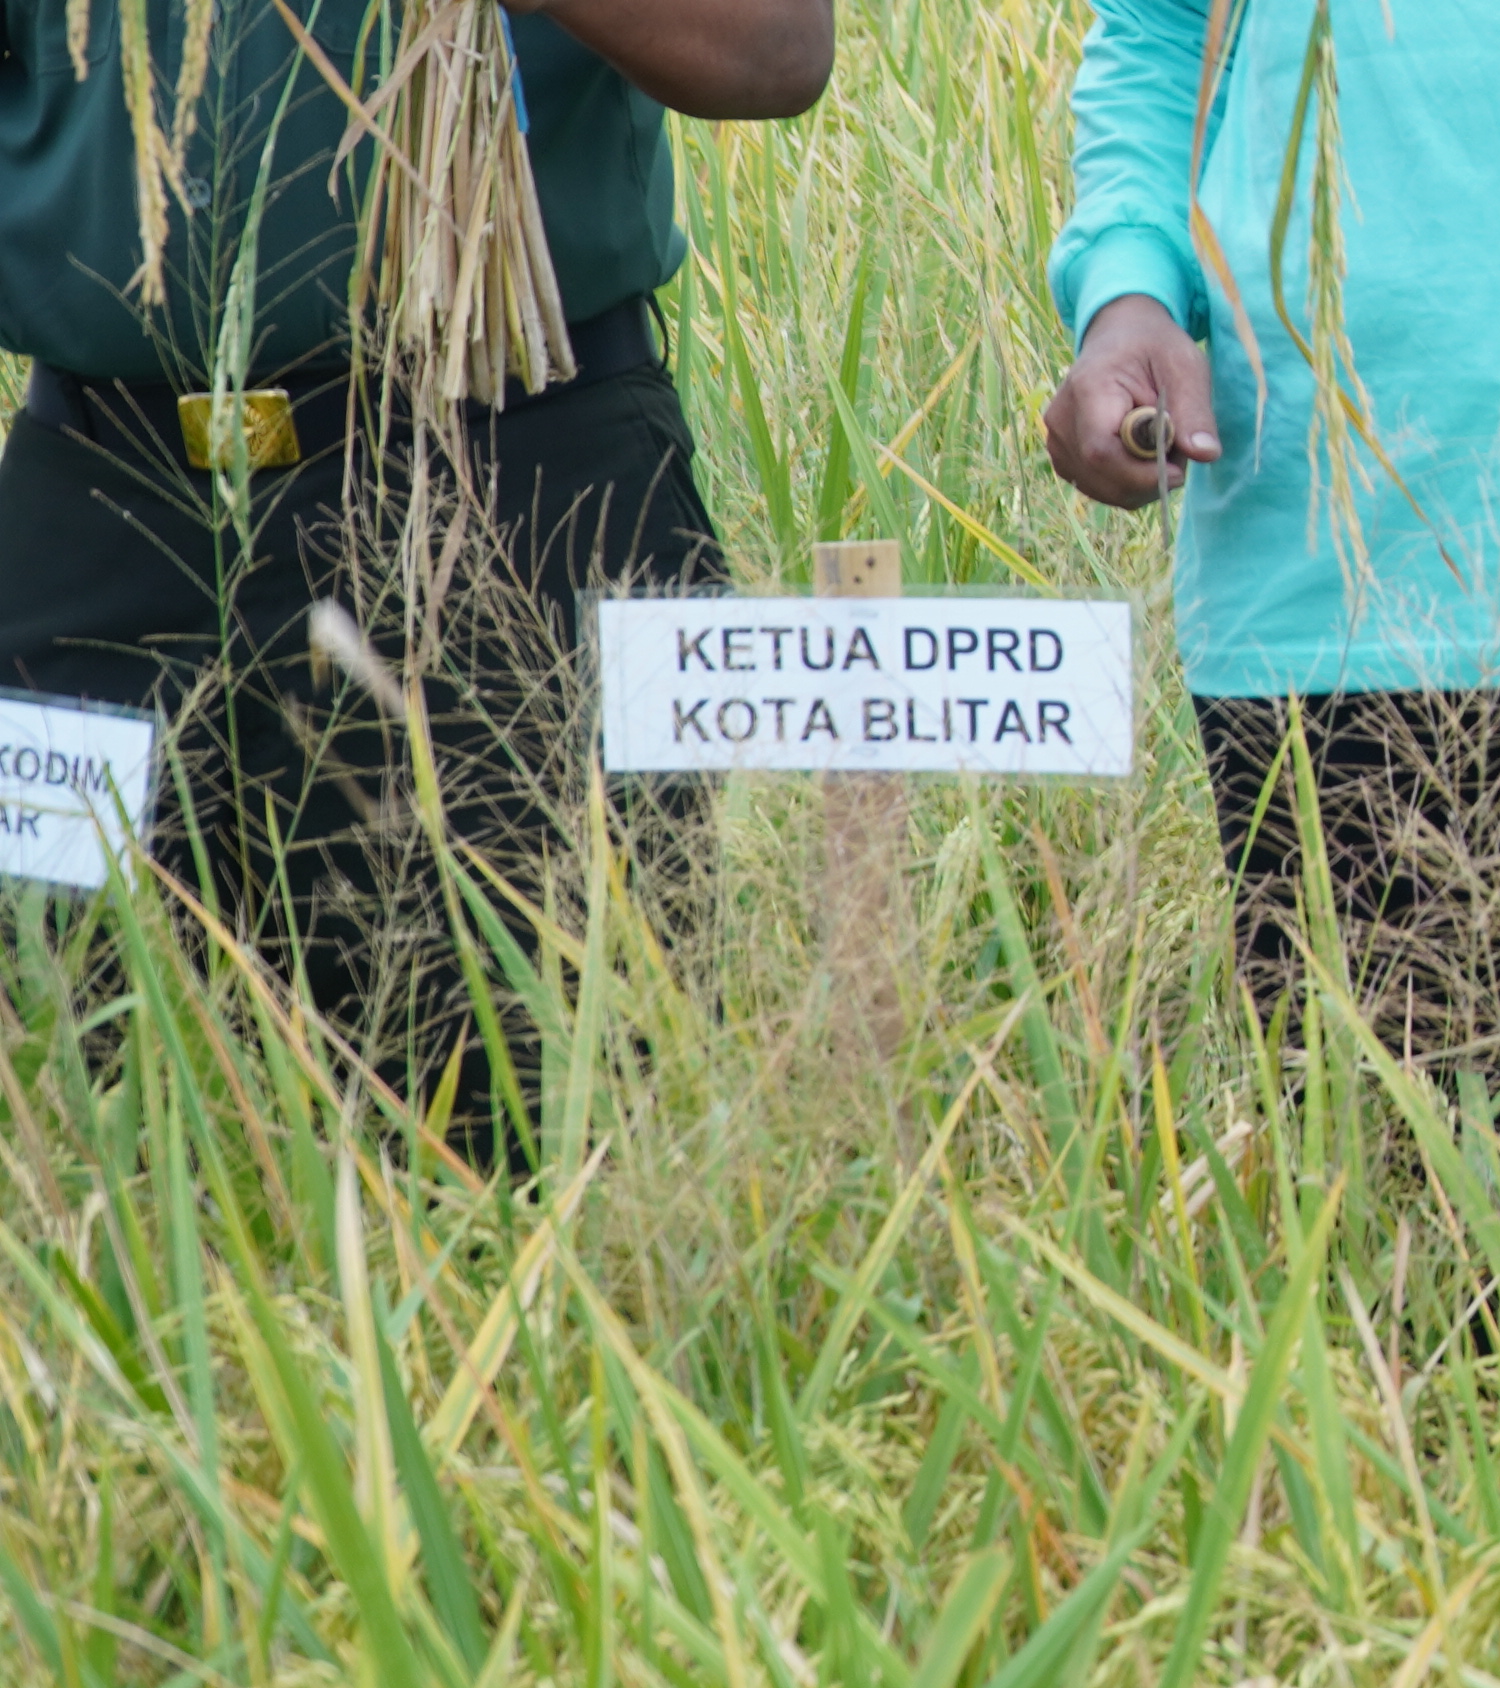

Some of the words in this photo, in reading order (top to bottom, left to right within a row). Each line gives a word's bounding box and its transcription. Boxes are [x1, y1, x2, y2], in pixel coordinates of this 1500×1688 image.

[676, 627, 881, 672] KETUA
[903, 627, 1064, 672] DPRD
[672, 698, 840, 743] KOTA
[862, 698, 1074, 745] BLITAR
